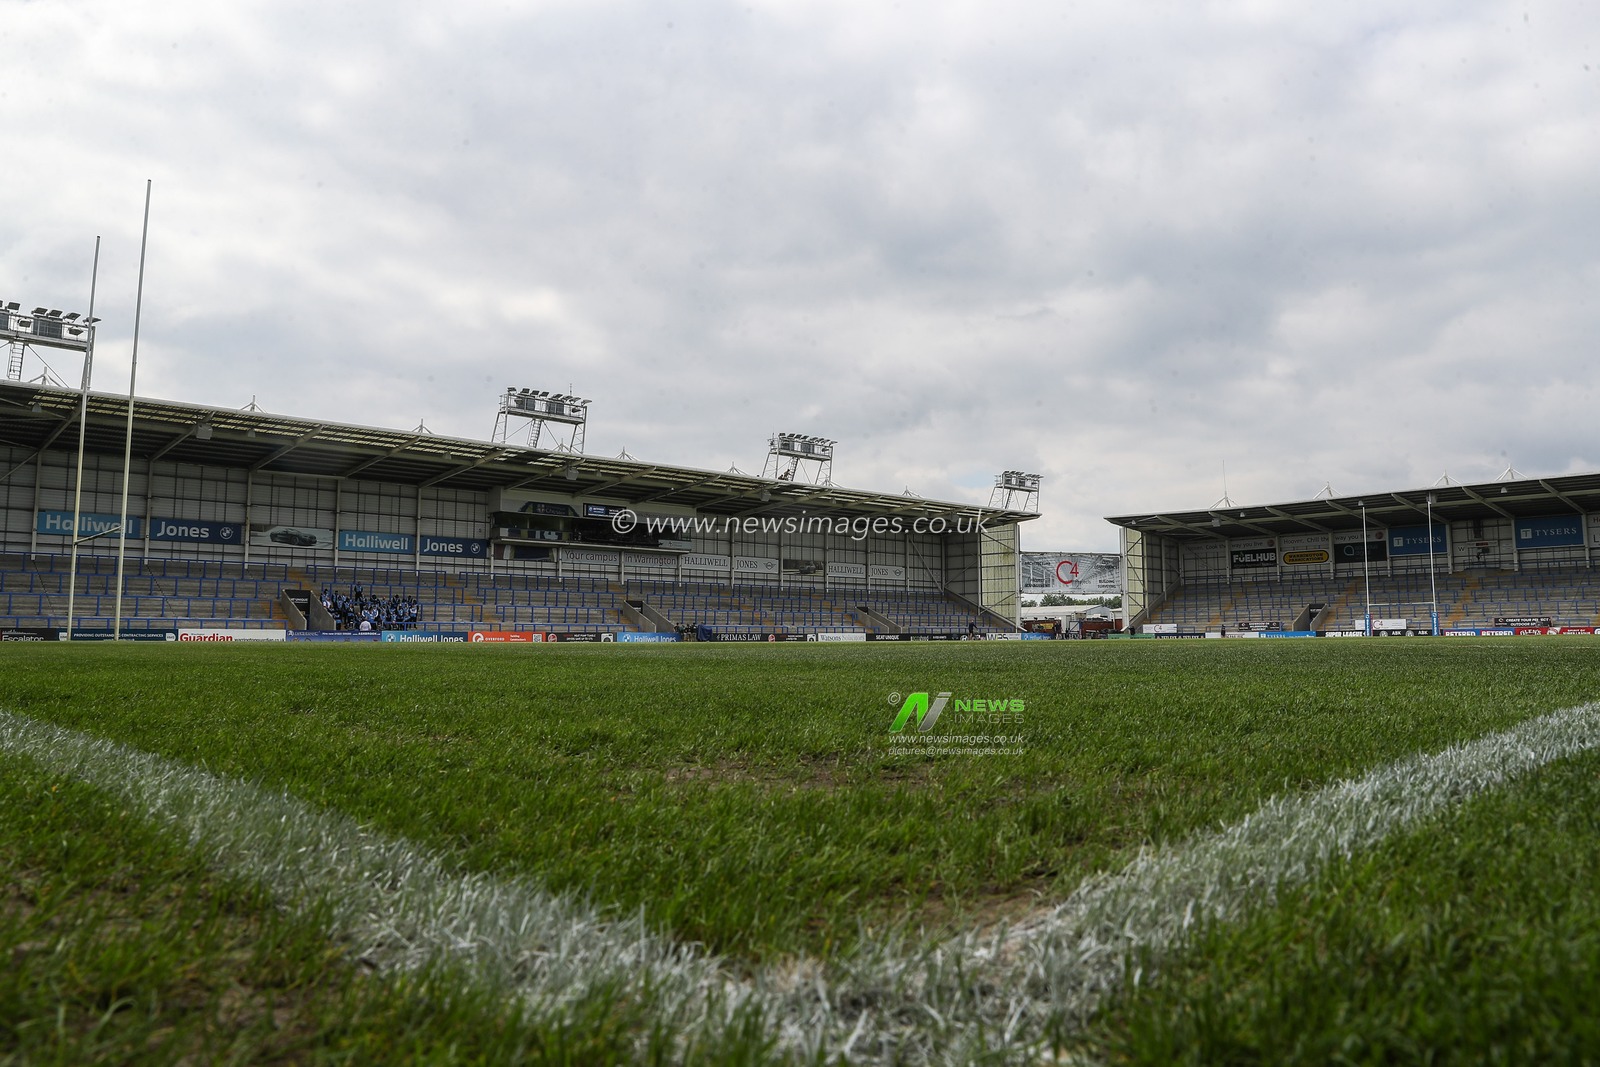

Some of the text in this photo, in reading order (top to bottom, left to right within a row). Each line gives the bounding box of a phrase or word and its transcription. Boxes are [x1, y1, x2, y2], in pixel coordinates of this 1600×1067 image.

[46, 514, 133, 534] Haliwel
[157, 521, 210, 538] Jones
[1535, 527, 1577, 536] TYSERS
[345, 533, 409, 550] Halliwell
[1406, 536, 1441, 545] TYSERS
[423, 539, 463, 553] Jones
[565, 550, 617, 563] Your campus
[625, 554, 676, 566] in Warrington
[1233, 552, 1276, 563] FUELHUB
[684, 557, 728, 567] HALLIWELL
[736, 560, 758, 570] JONES
[828, 565, 864, 575] HALLIWELL
[871, 568, 889, 577] JONES
[180, 633, 233, 641] Guardian
[400, 634, 464, 642] Halliwell Jones
